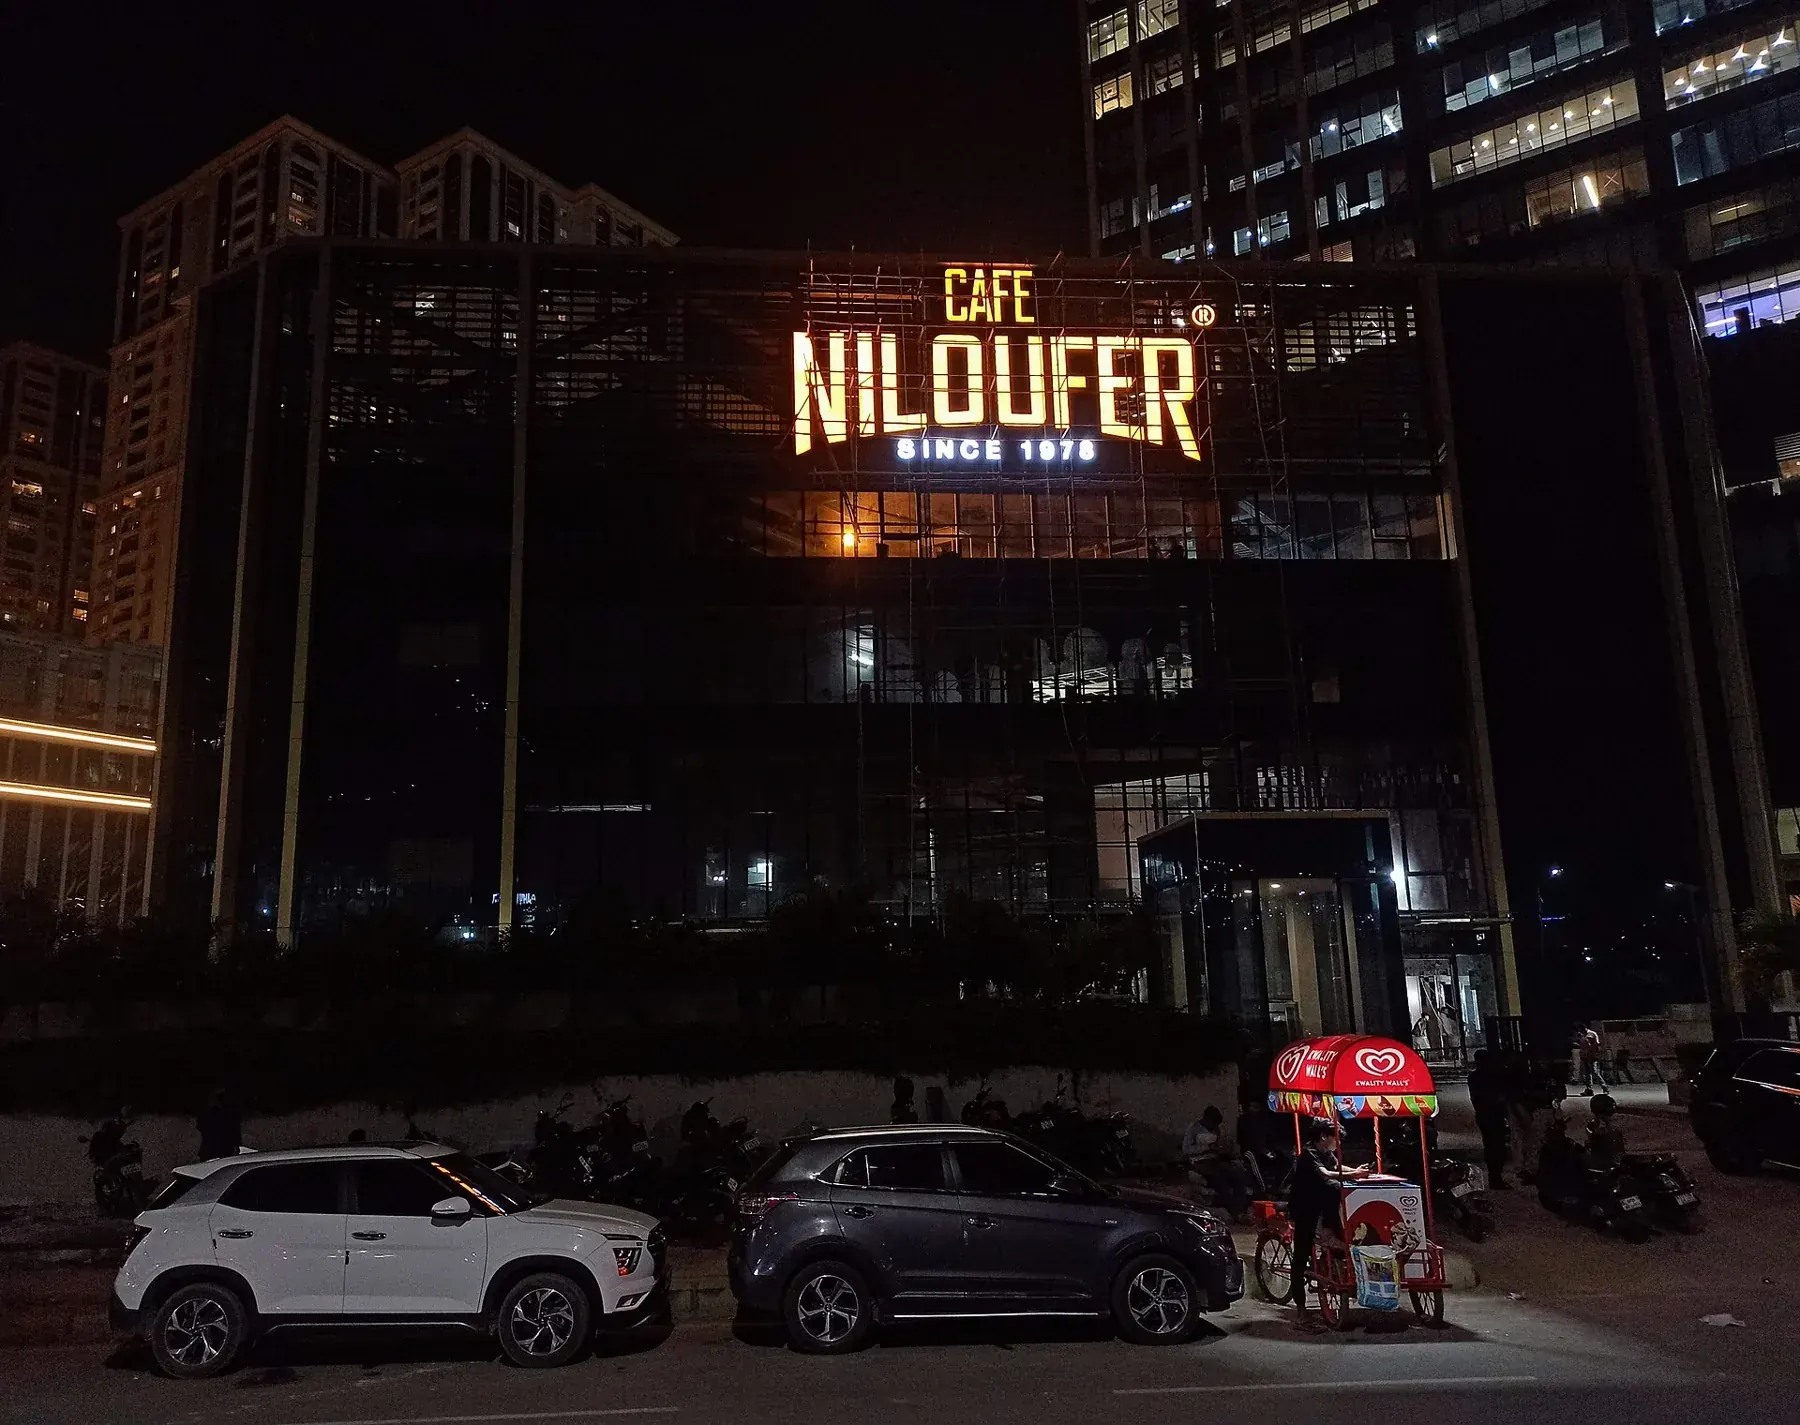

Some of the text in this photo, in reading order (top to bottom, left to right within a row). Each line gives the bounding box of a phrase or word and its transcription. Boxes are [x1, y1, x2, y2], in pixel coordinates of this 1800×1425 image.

[944, 268, 1034, 323] CAFE
[793, 331, 1201, 461] NILOUFER
[897, 439, 1095, 461] SINCE 1978
[1306, 1063, 1328, 1079] WALL'S
[1386, 1079, 1409, 1087] WALL'S
